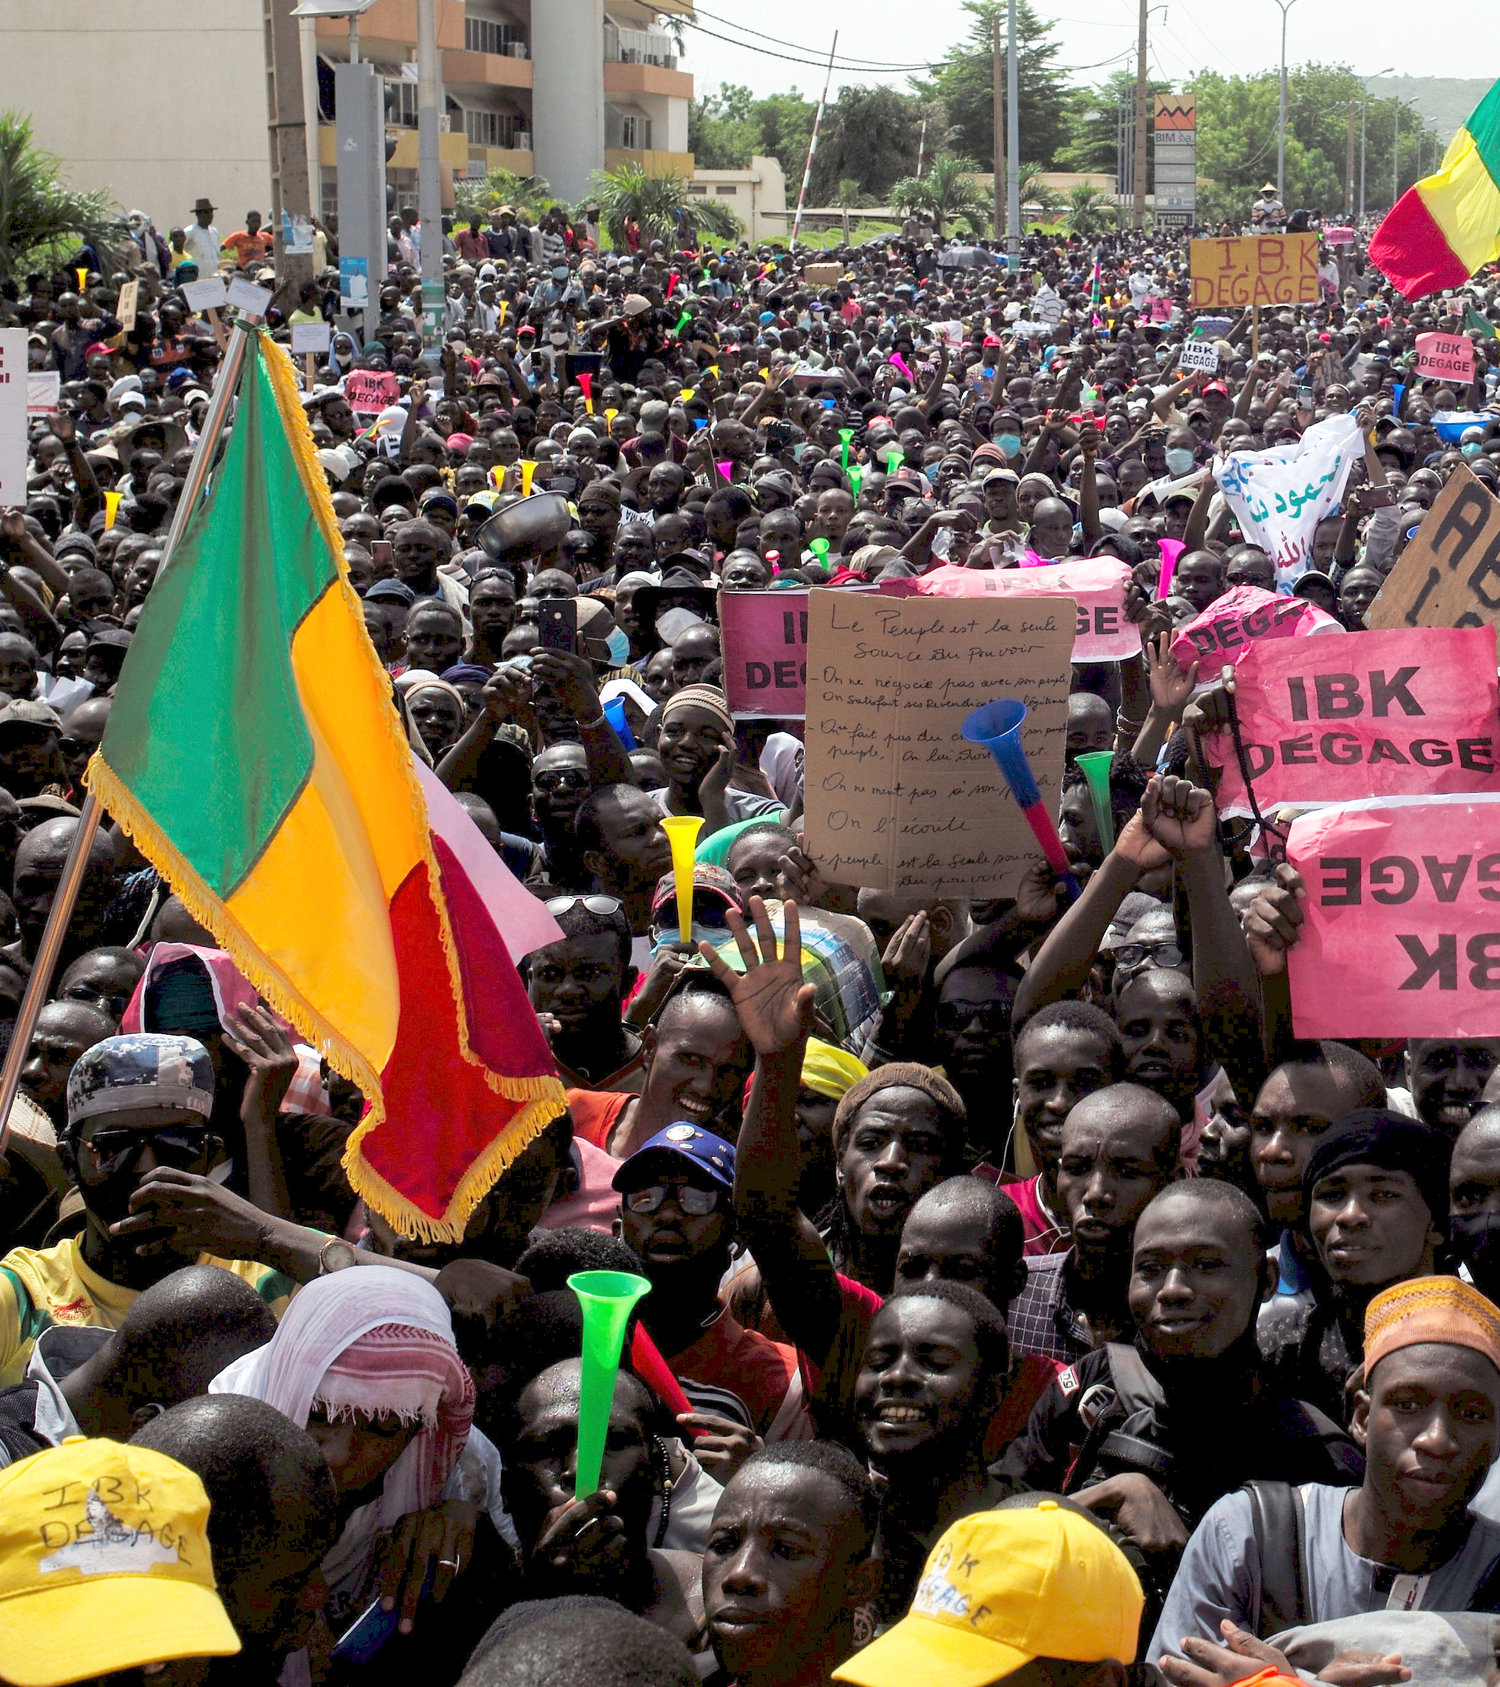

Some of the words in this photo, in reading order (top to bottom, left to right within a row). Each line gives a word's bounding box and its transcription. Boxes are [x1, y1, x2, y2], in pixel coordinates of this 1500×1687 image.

[1155, 132, 1176, 143] BIM
[1190, 272, 1317, 308] DEGAGE
[1187, 342, 1213, 355] IBK
[1435, 340, 1461, 356] IBK
[1182, 353, 1218, 369] DEGAGE
[1420, 356, 1470, 373] DEGAGE
[364, 377, 385, 393] IBK
[832, 602, 865, 633] Le
[874, 609, 945, 644] Peuple
[950, 619, 979, 634] est
[985, 618, 1012, 634] la
[1189, 600, 1301, 658] DEGA
[823, 665, 844, 685] On
[848, 678, 864, 687] ne
[938, 677, 975, 700] pas
[981, 677, 1013, 688] avec
[1286, 665, 1427, 723] IBK
[822, 691, 843, 702] On
[820, 718, 839, 736] On
[848, 722, 878, 747] fait
[1243, 731, 1496, 781] DEGAGE
[822, 771, 846, 792] On
[871, 781, 905, 797] ment
[908, 786, 937, 805] pas
[827, 809, 862, 831] On
